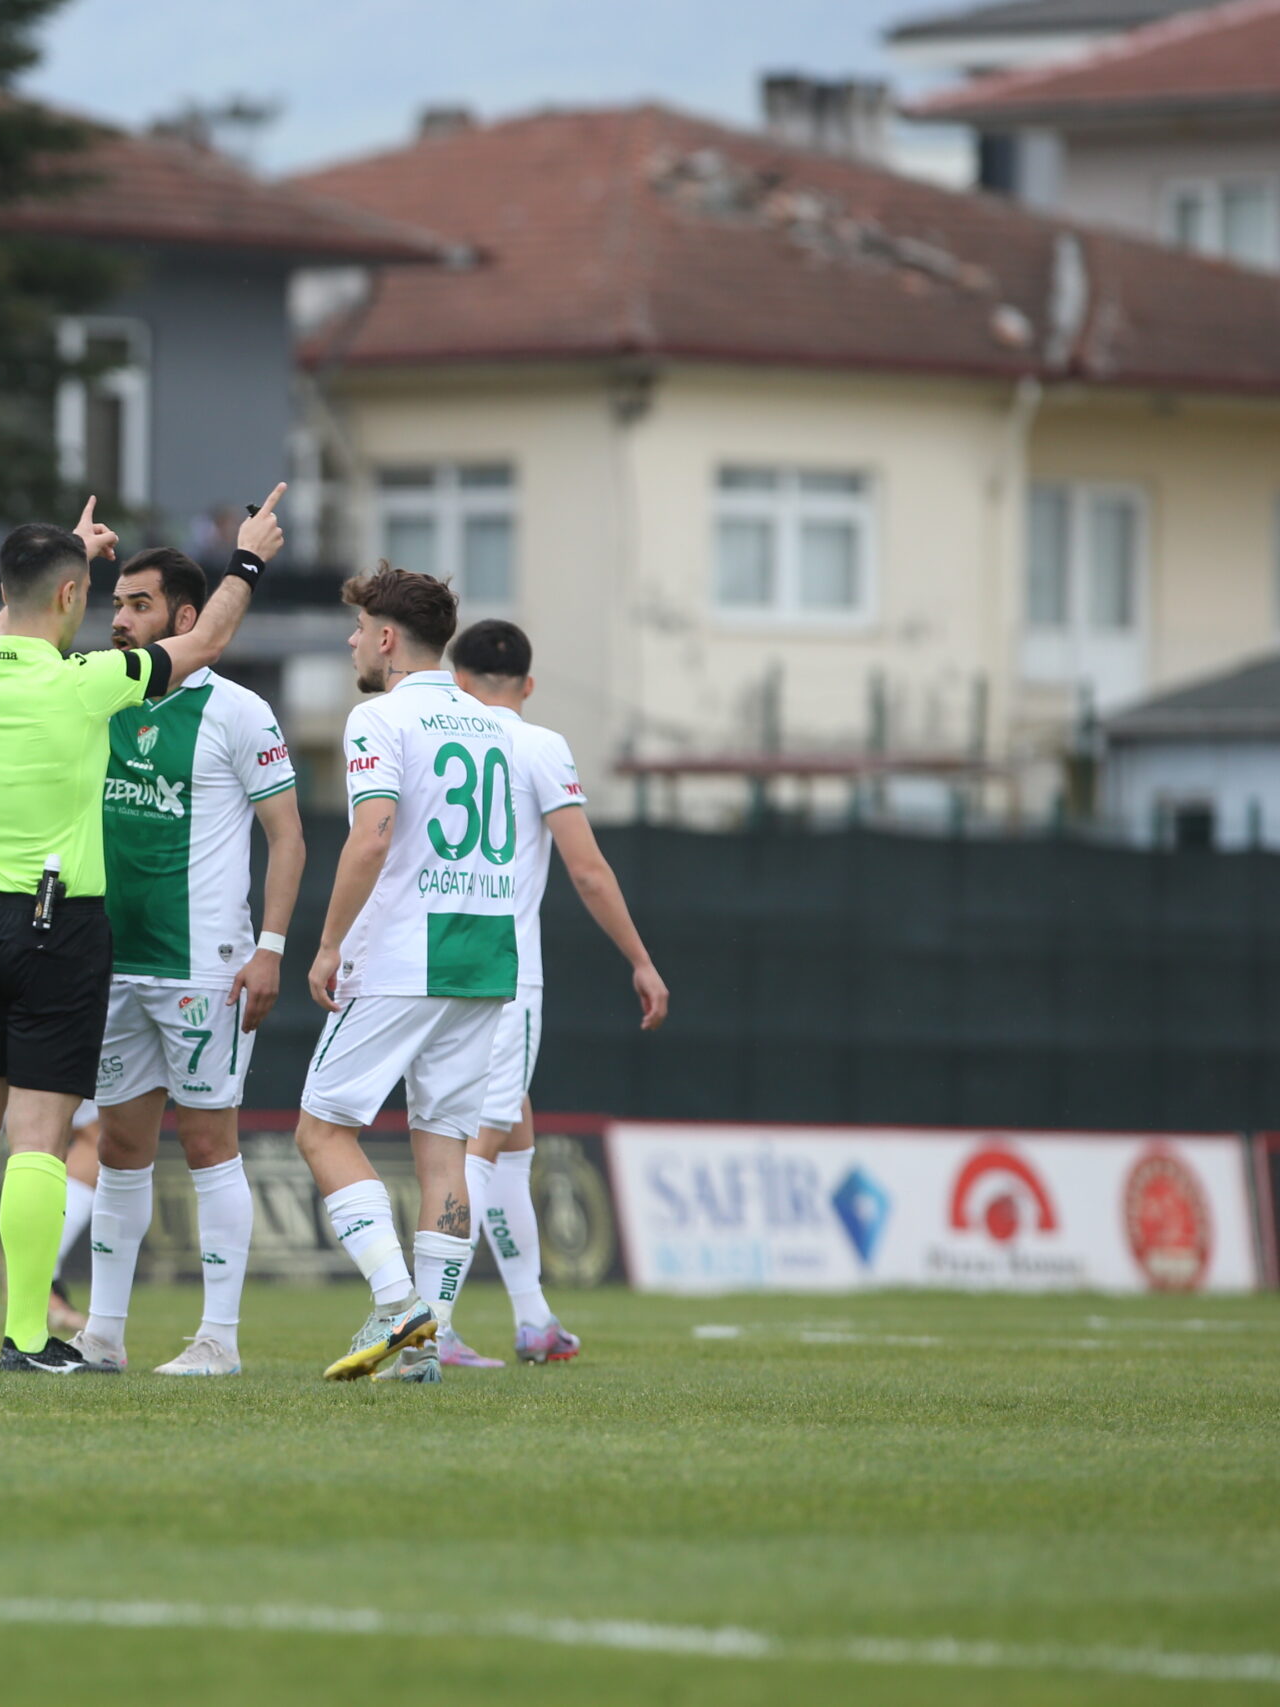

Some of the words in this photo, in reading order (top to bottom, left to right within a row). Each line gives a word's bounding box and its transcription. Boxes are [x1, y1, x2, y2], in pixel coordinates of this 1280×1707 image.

[348, 756, 380, 773] nur
[427, 741, 517, 865] 30
[182, 1030, 213, 1074] 7
[439, 1260, 463, 1301] roma
